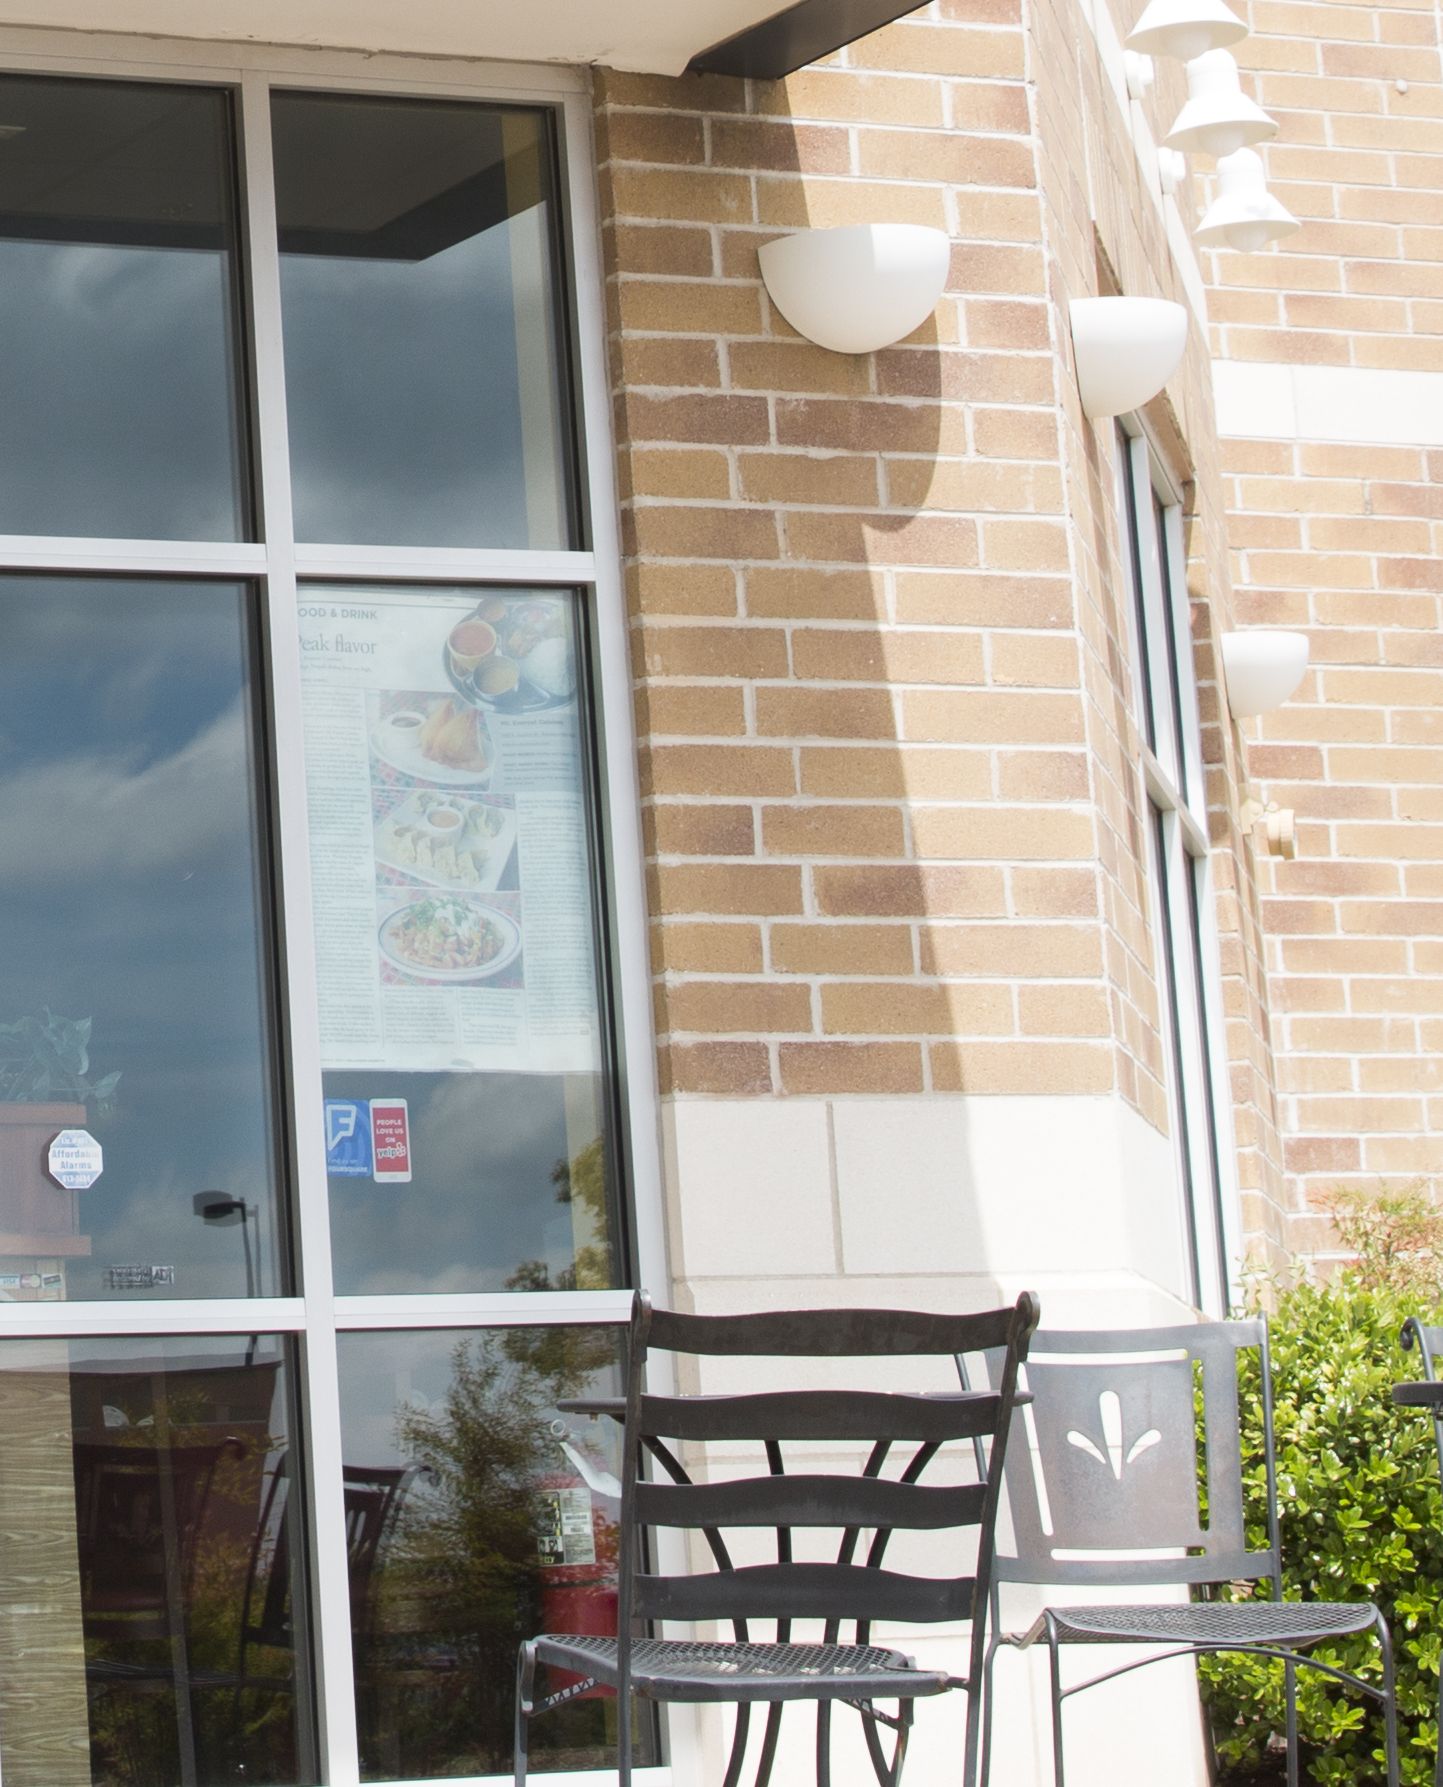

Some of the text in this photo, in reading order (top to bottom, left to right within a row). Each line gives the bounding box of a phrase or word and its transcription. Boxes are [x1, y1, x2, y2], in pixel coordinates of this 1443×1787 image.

[297, 607, 378, 620] OOD & DRINK
[334, 633, 378, 654] flavor
[376, 1146, 398, 1159] yelp
[60, 1161, 92, 1170] Alarms
